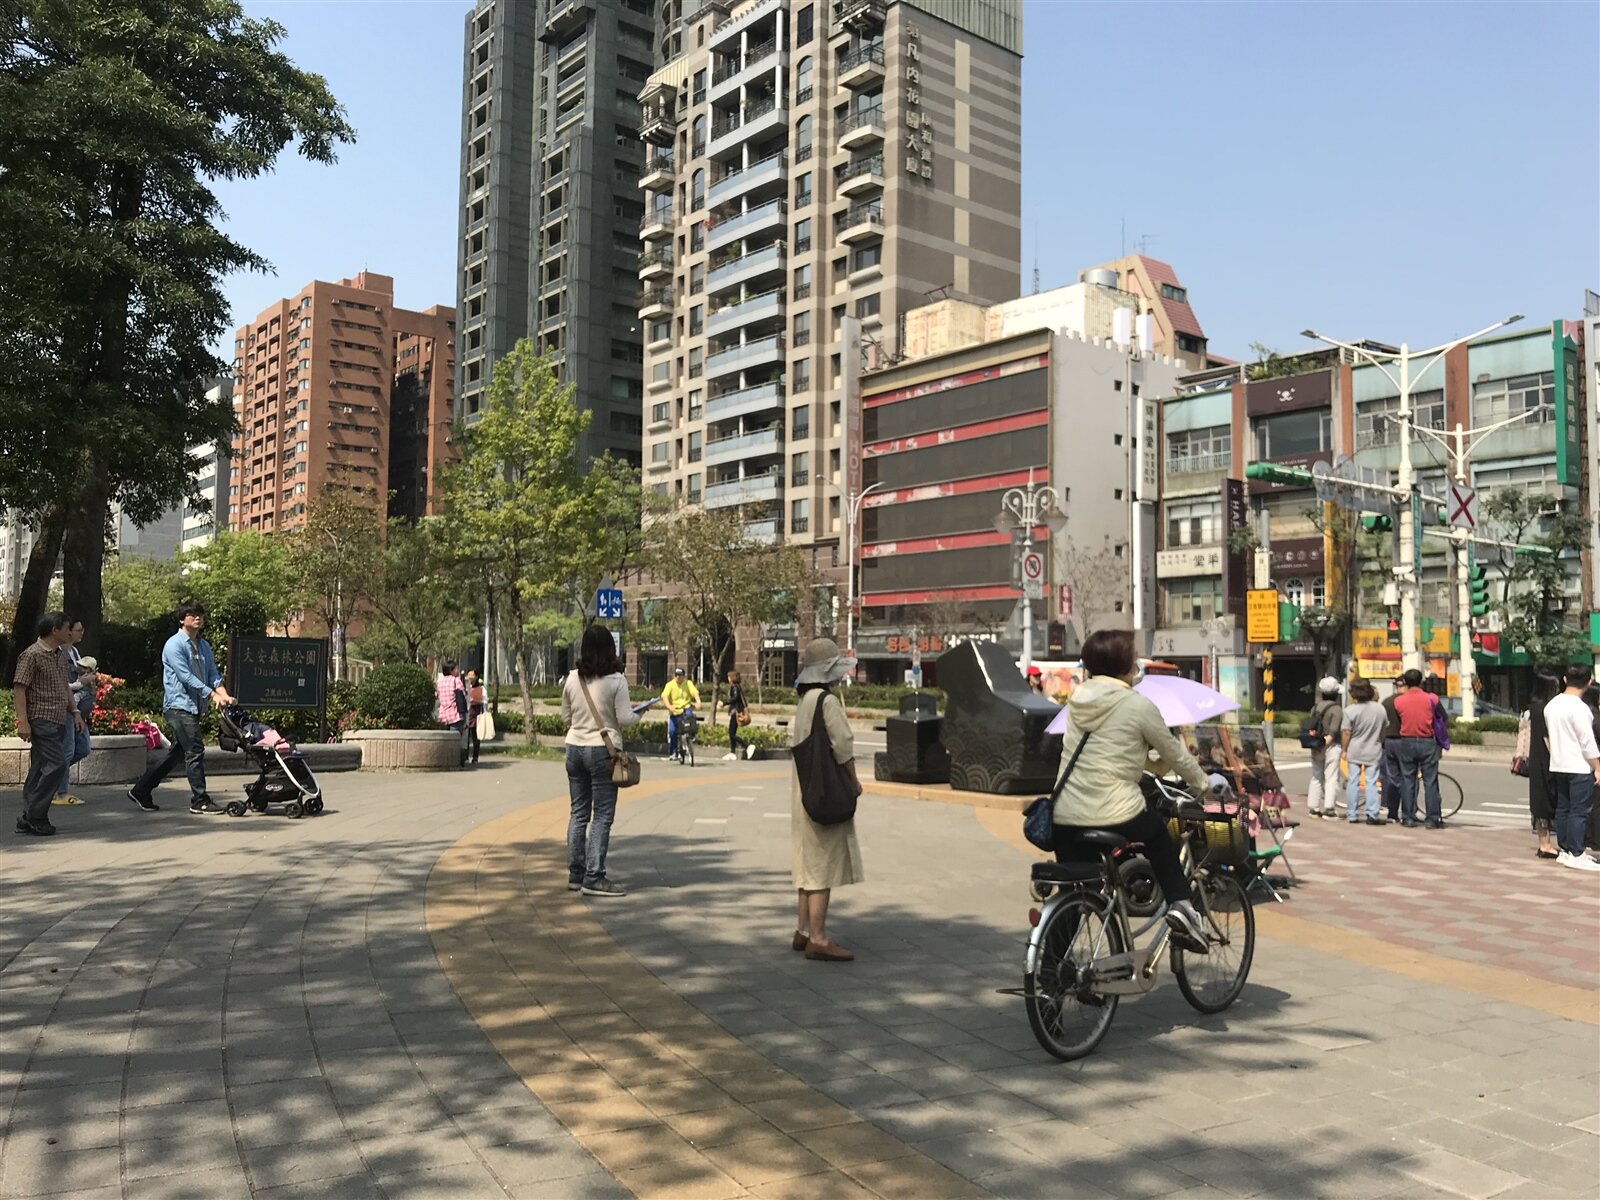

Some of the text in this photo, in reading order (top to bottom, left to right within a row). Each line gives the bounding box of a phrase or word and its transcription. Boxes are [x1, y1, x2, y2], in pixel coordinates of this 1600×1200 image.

[243, 647, 316, 666] 大安森林公園
[254, 666, 305, 678] Daan Park
